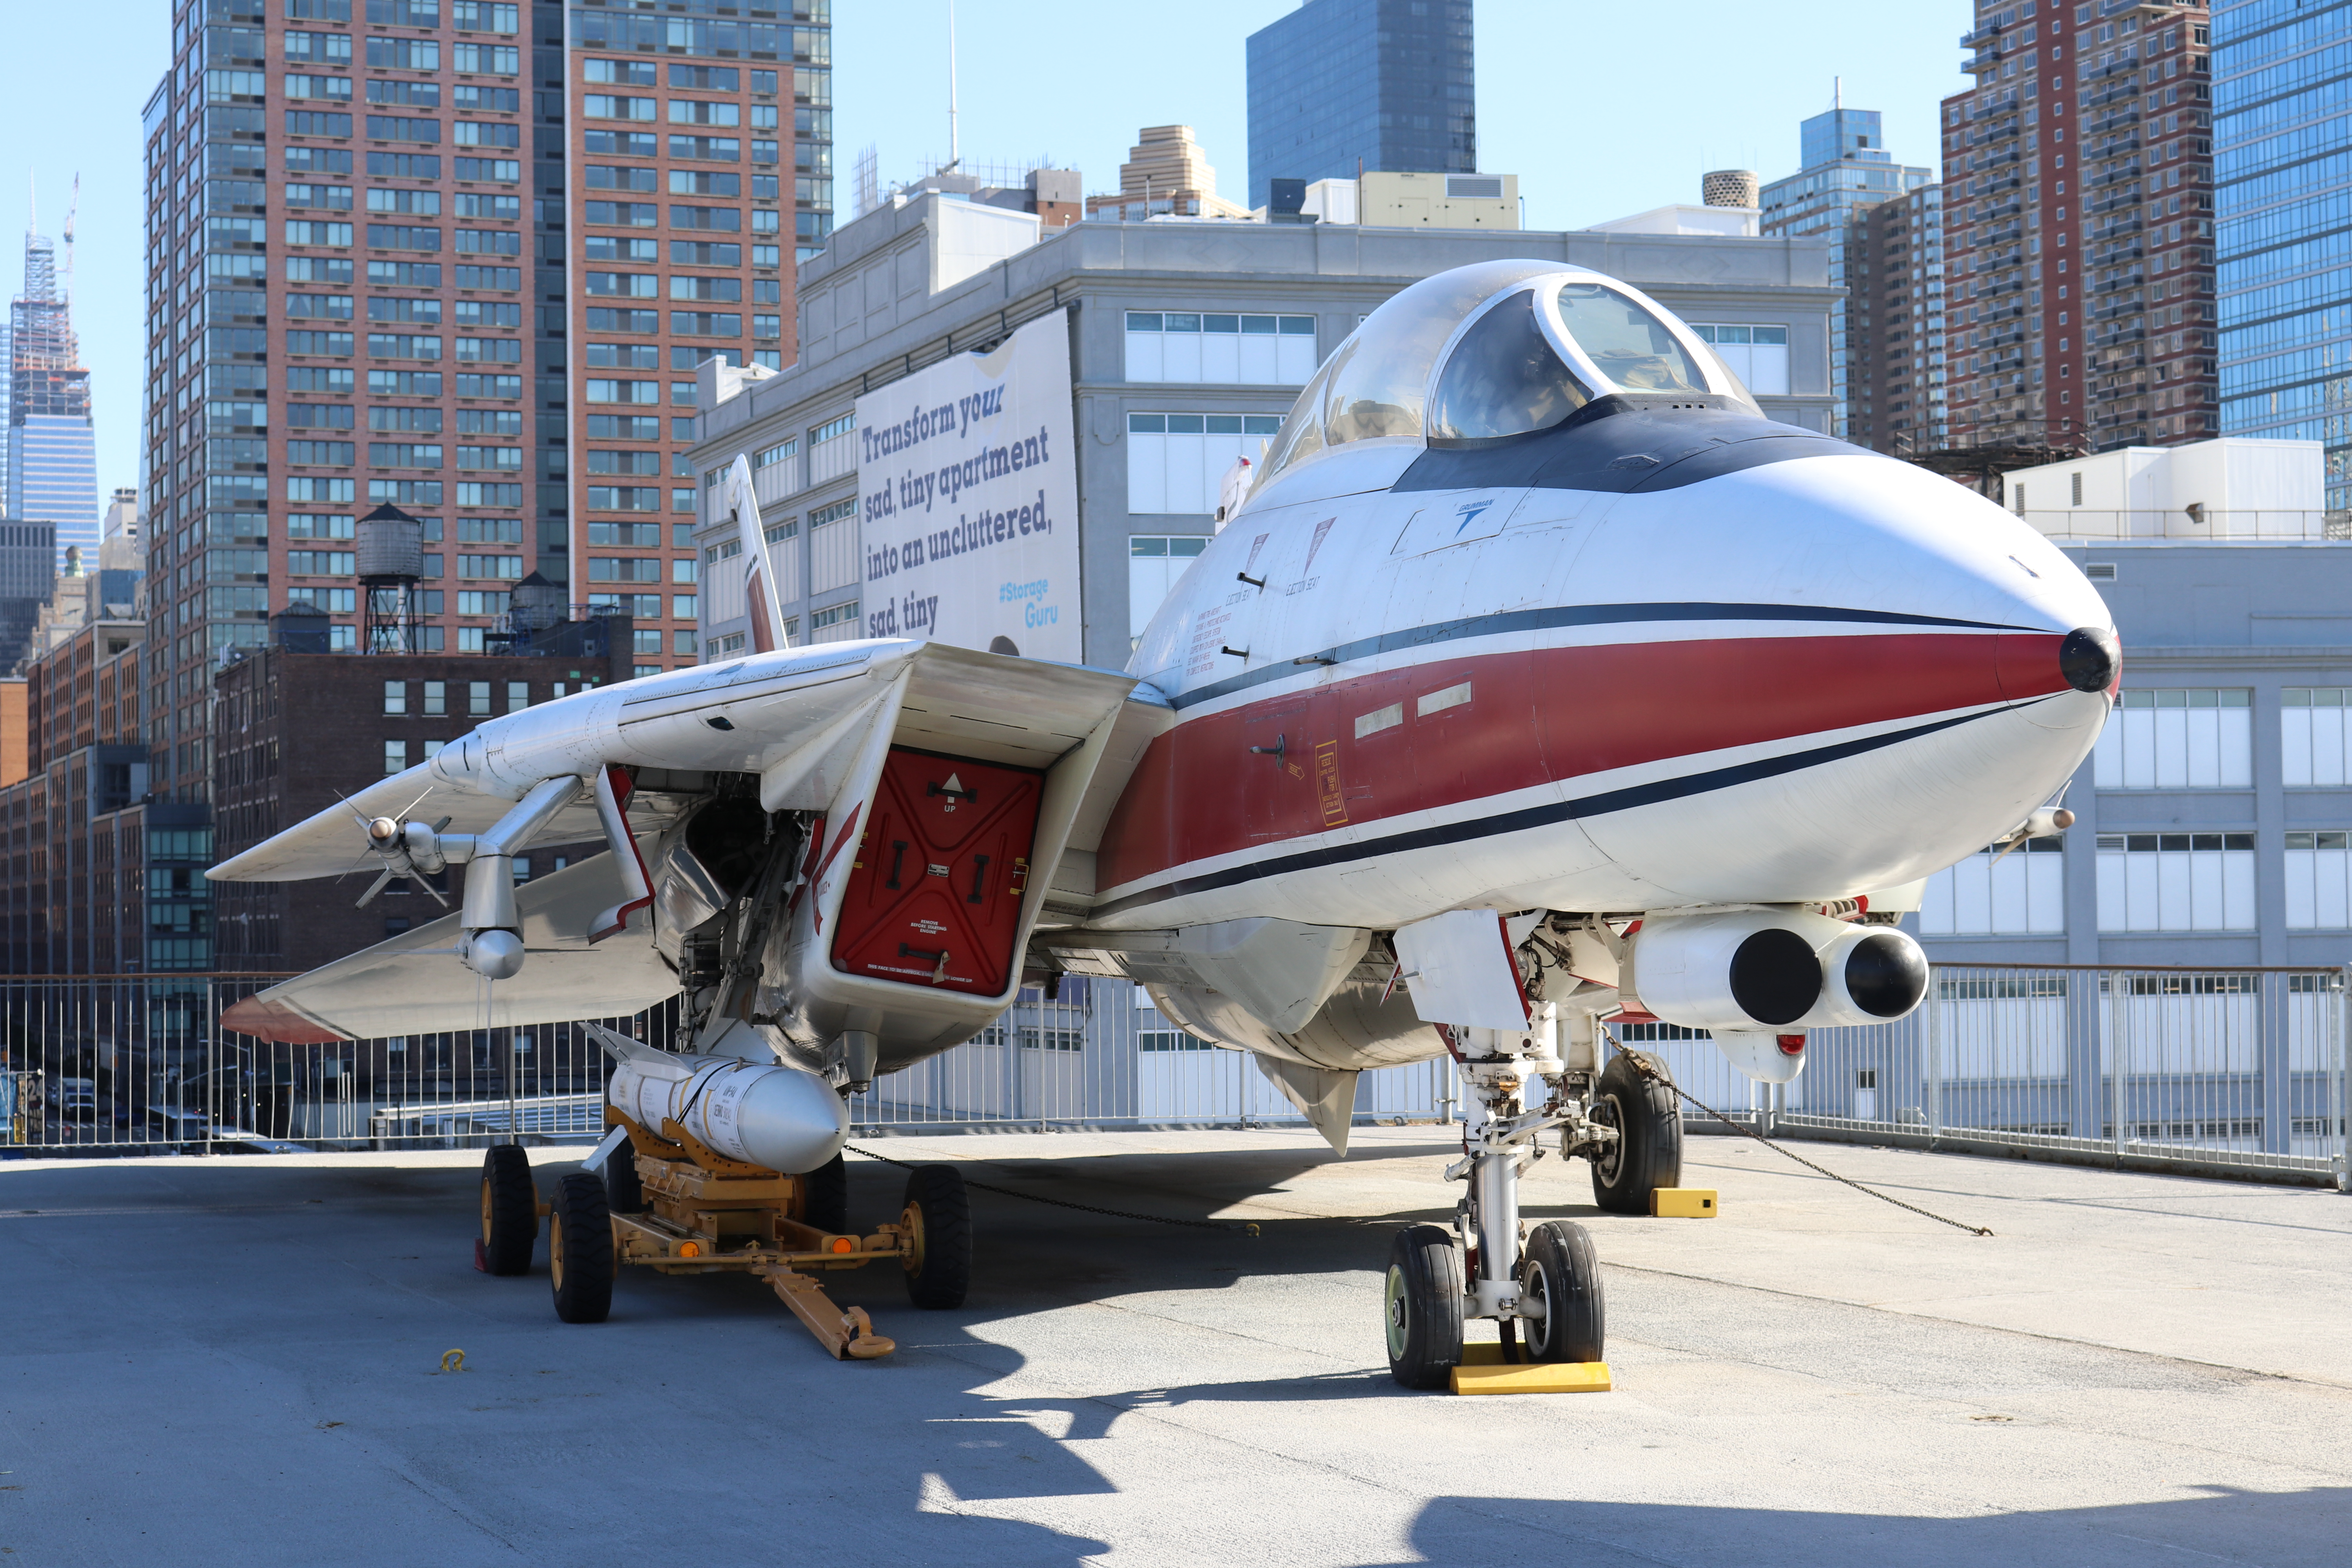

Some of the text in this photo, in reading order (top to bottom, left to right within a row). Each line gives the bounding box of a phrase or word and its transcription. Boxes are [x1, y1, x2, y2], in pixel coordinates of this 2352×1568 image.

[863, 383, 1005, 463] Transform your
[865, 425, 1049, 523] sad, tiny apartment
[1459, 499, 1495, 512] GRUMMAN
[867, 489, 1052, 581] into an uncluttered,
[999, 579, 1048, 603] #Storage
[1225, 588, 1253, 606] EJECTION SEAT
[1286, 576, 1320, 597] EJECTION SEAT
[869, 590, 938, 639] sad, tiny
[1025, 602, 1058, 628] Guru
[1290, 766, 1298, 774] RESCUE
[1321, 757, 1331, 767] RESCUE
